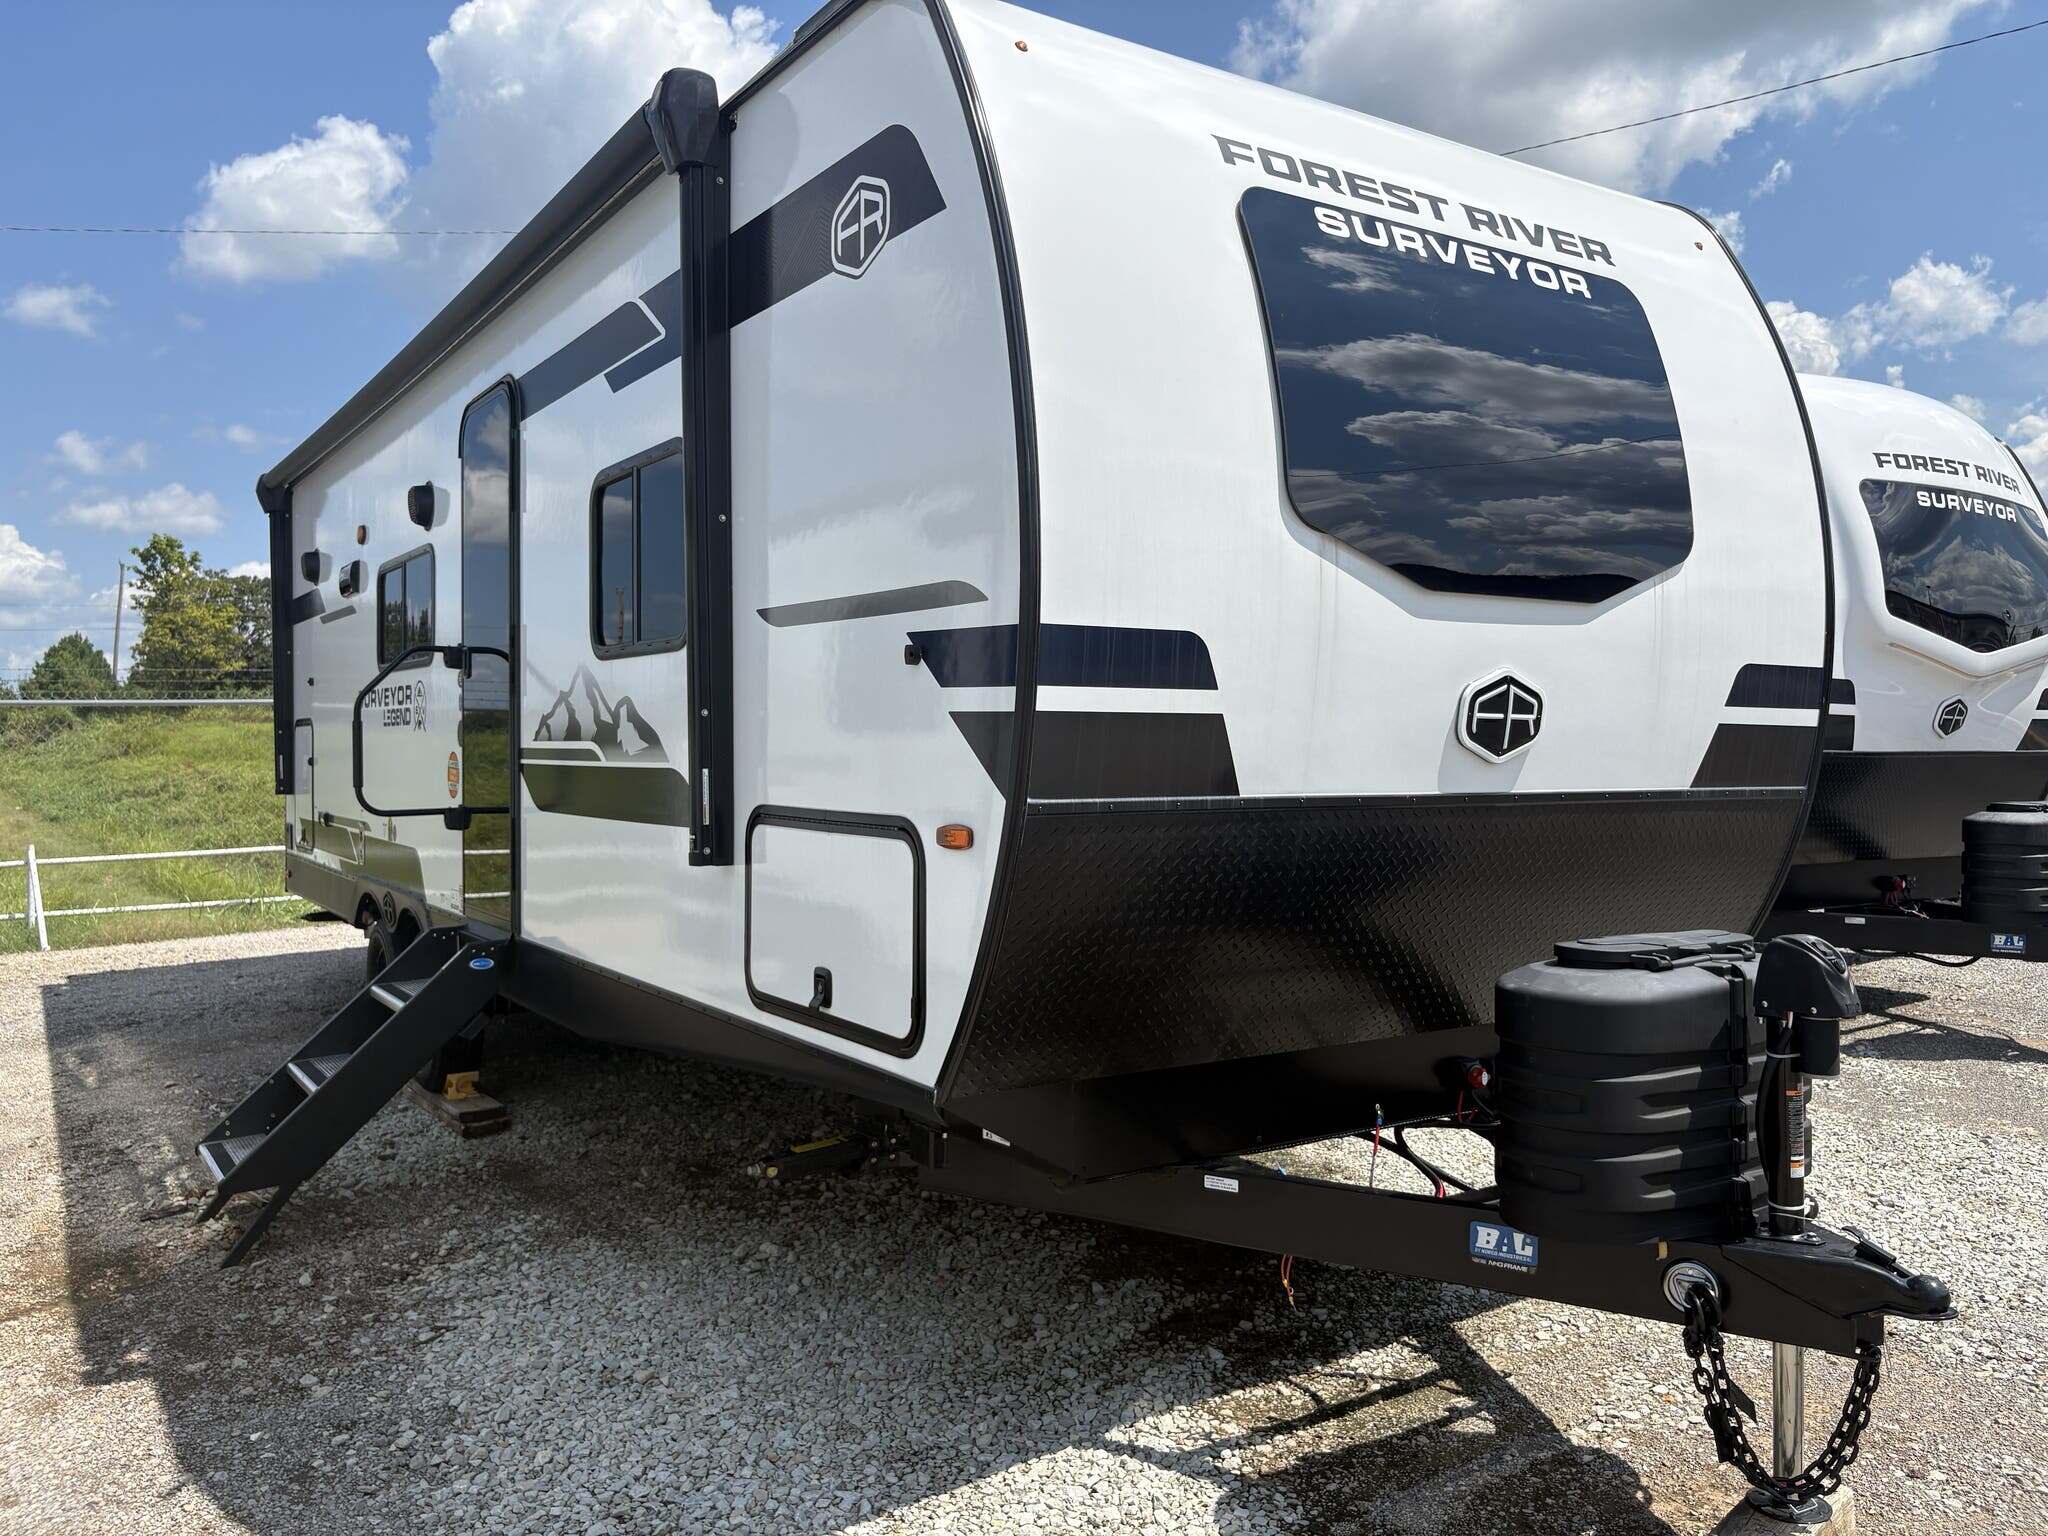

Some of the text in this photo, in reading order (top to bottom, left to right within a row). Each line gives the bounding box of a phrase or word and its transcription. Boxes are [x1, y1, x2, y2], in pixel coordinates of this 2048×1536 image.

[1210, 134, 1616, 267] FOREST RIVER
[1313, 206, 1593, 299] SURVEYOR
[1872, 452, 2022, 495] FOREST RIVER
[1916, 491, 2017, 523] SURVEYOR
[383, 707, 412, 727] LEGEND
[1475, 1226, 1533, 1257] BAL
